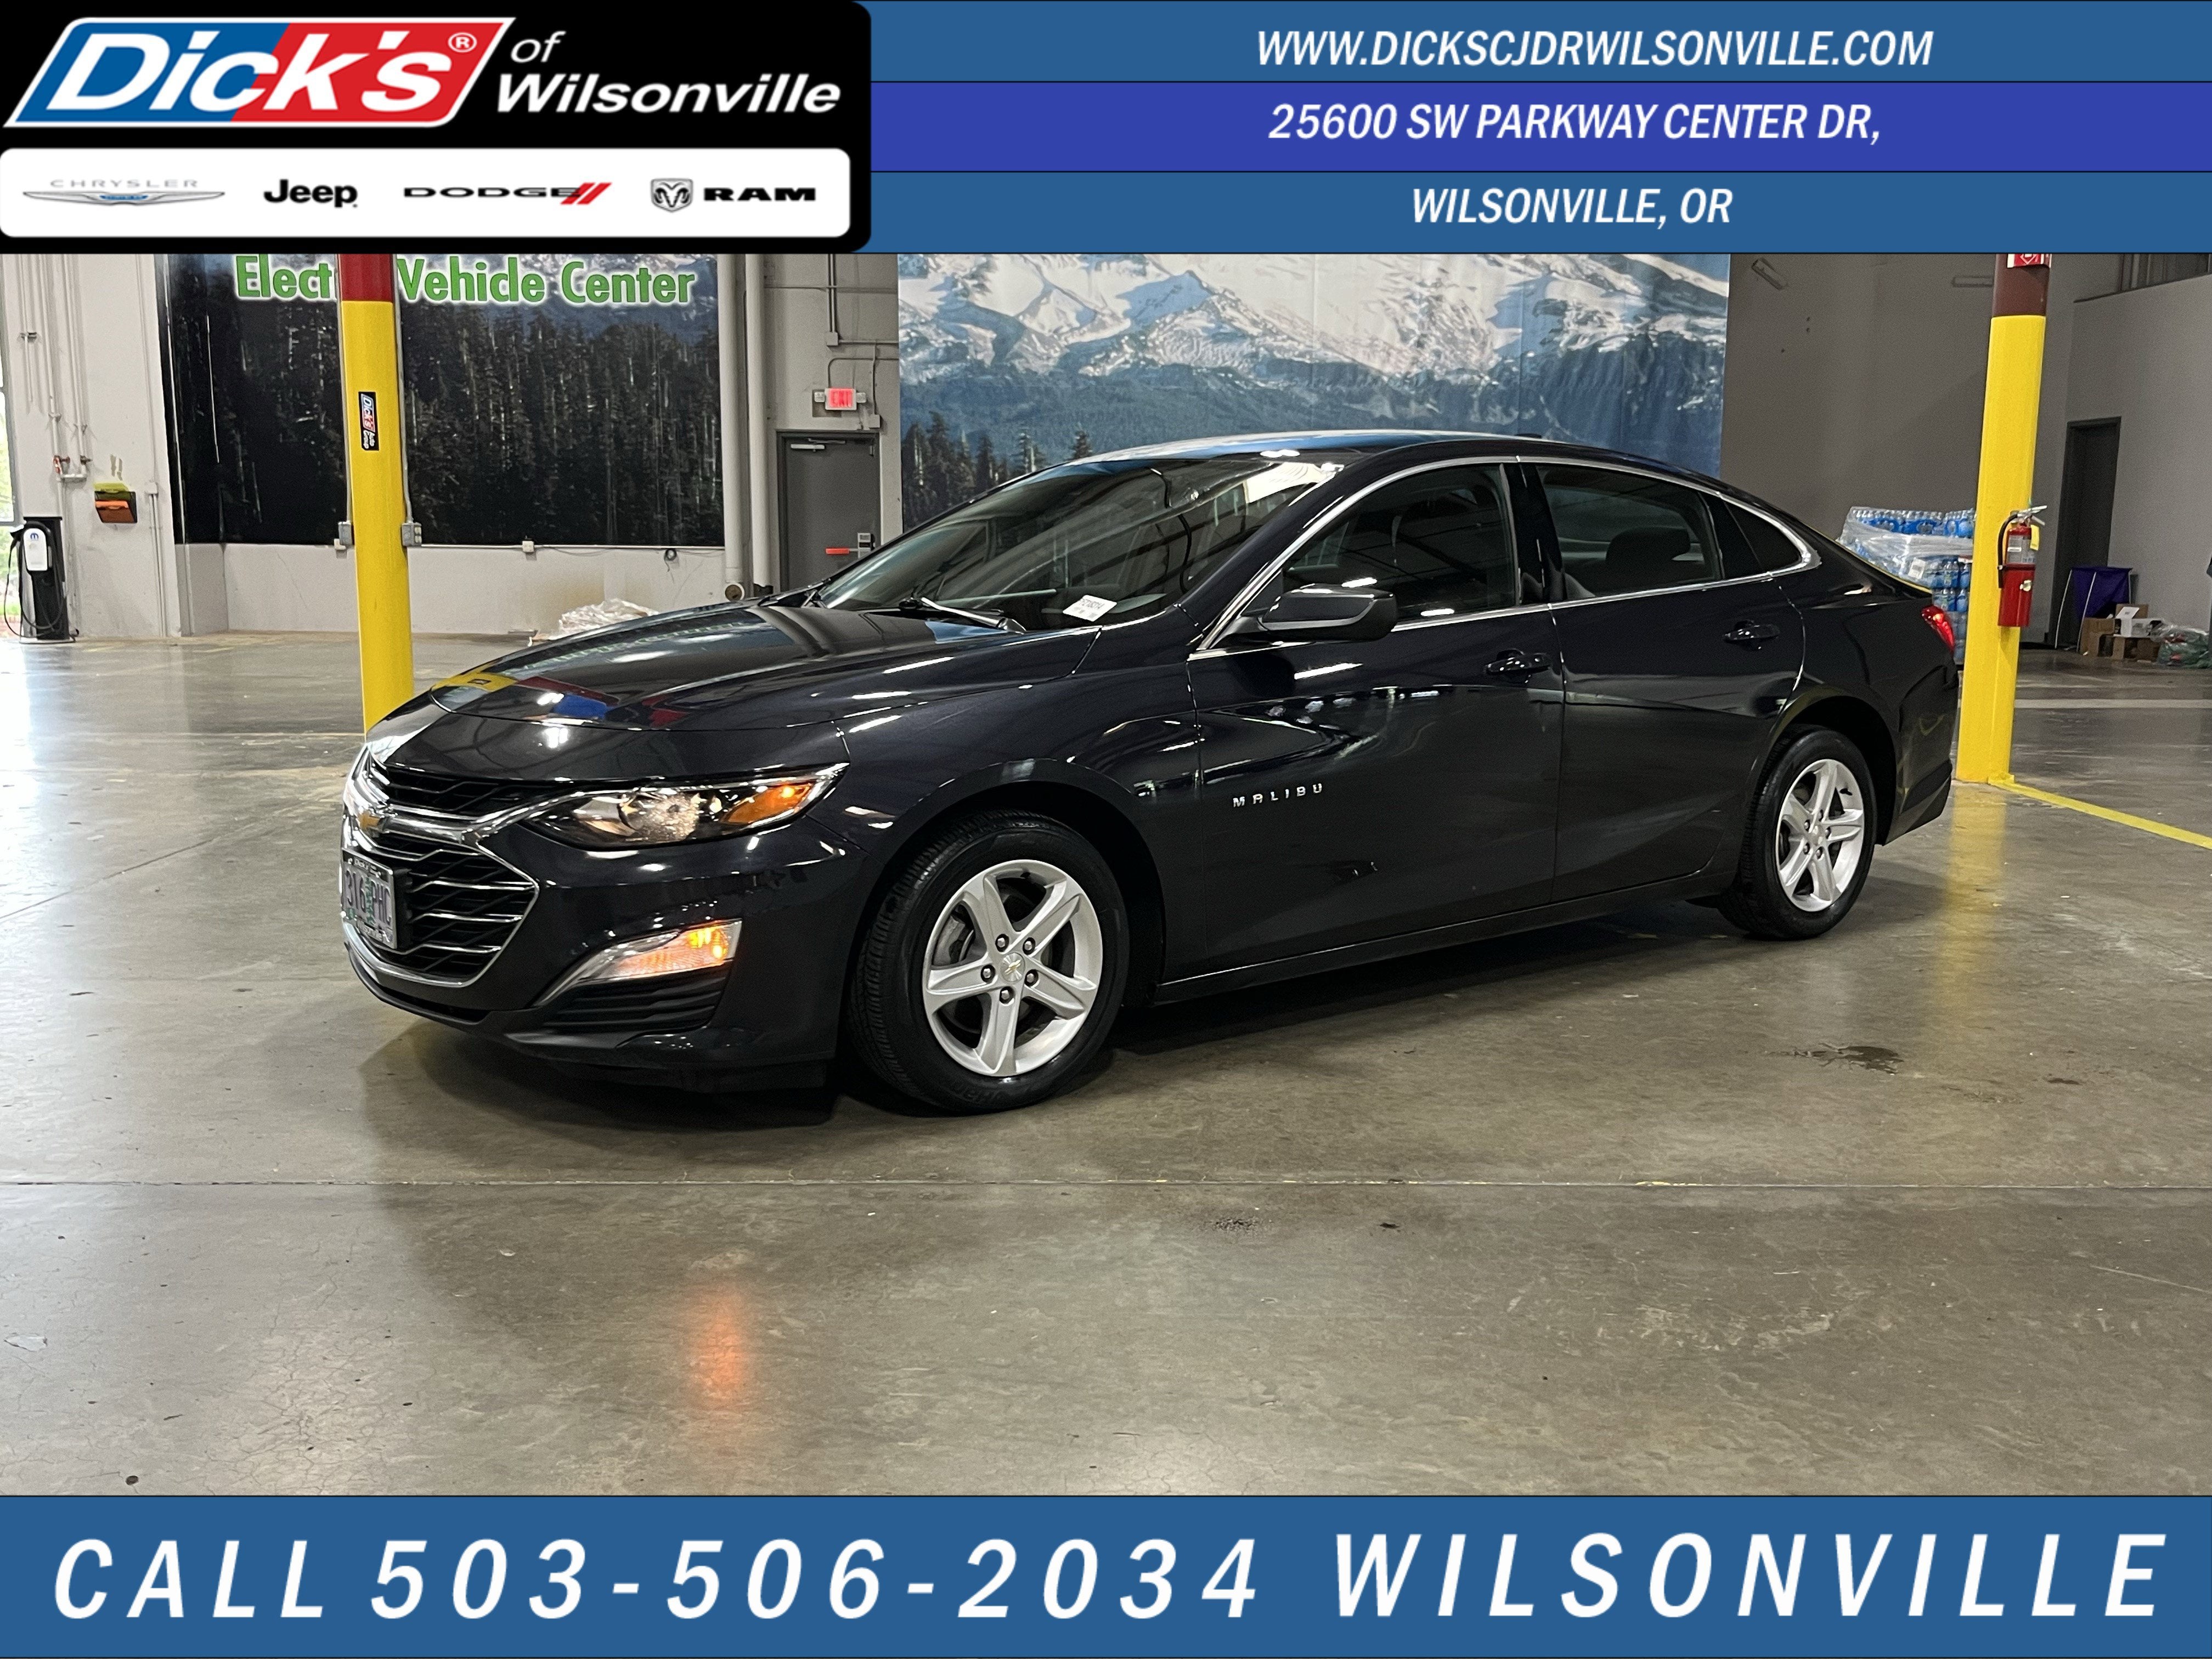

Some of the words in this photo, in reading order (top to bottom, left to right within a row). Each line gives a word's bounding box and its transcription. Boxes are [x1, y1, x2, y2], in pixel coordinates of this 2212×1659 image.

[396, 256, 545, 302] Vehicle
[561, 261, 695, 303] Center
[1233, 783, 1323, 808] MALIBU
